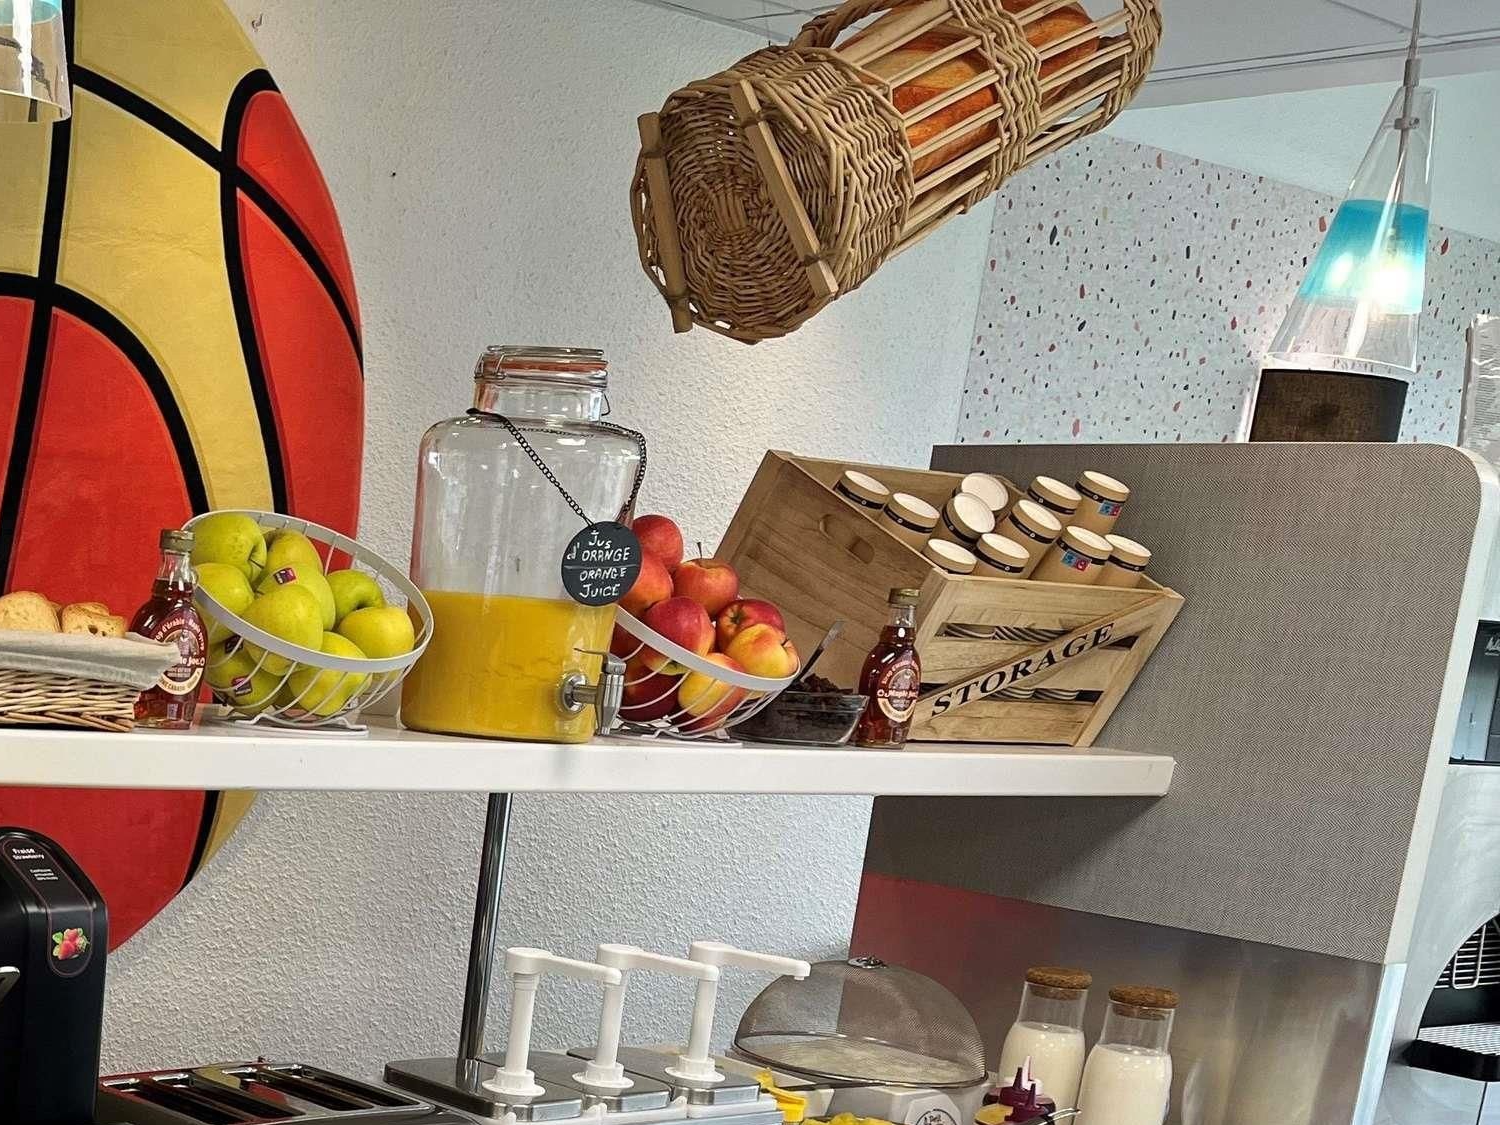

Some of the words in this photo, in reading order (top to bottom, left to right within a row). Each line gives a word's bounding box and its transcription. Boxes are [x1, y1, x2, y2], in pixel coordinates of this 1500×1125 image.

[588, 530, 612, 549] Jus
[581, 547, 631, 562] ORANGE
[580, 567, 627, 581] ORANGE
[579, 583, 621, 598] JUICE
[931, 622, 1115, 717] STORAGE
